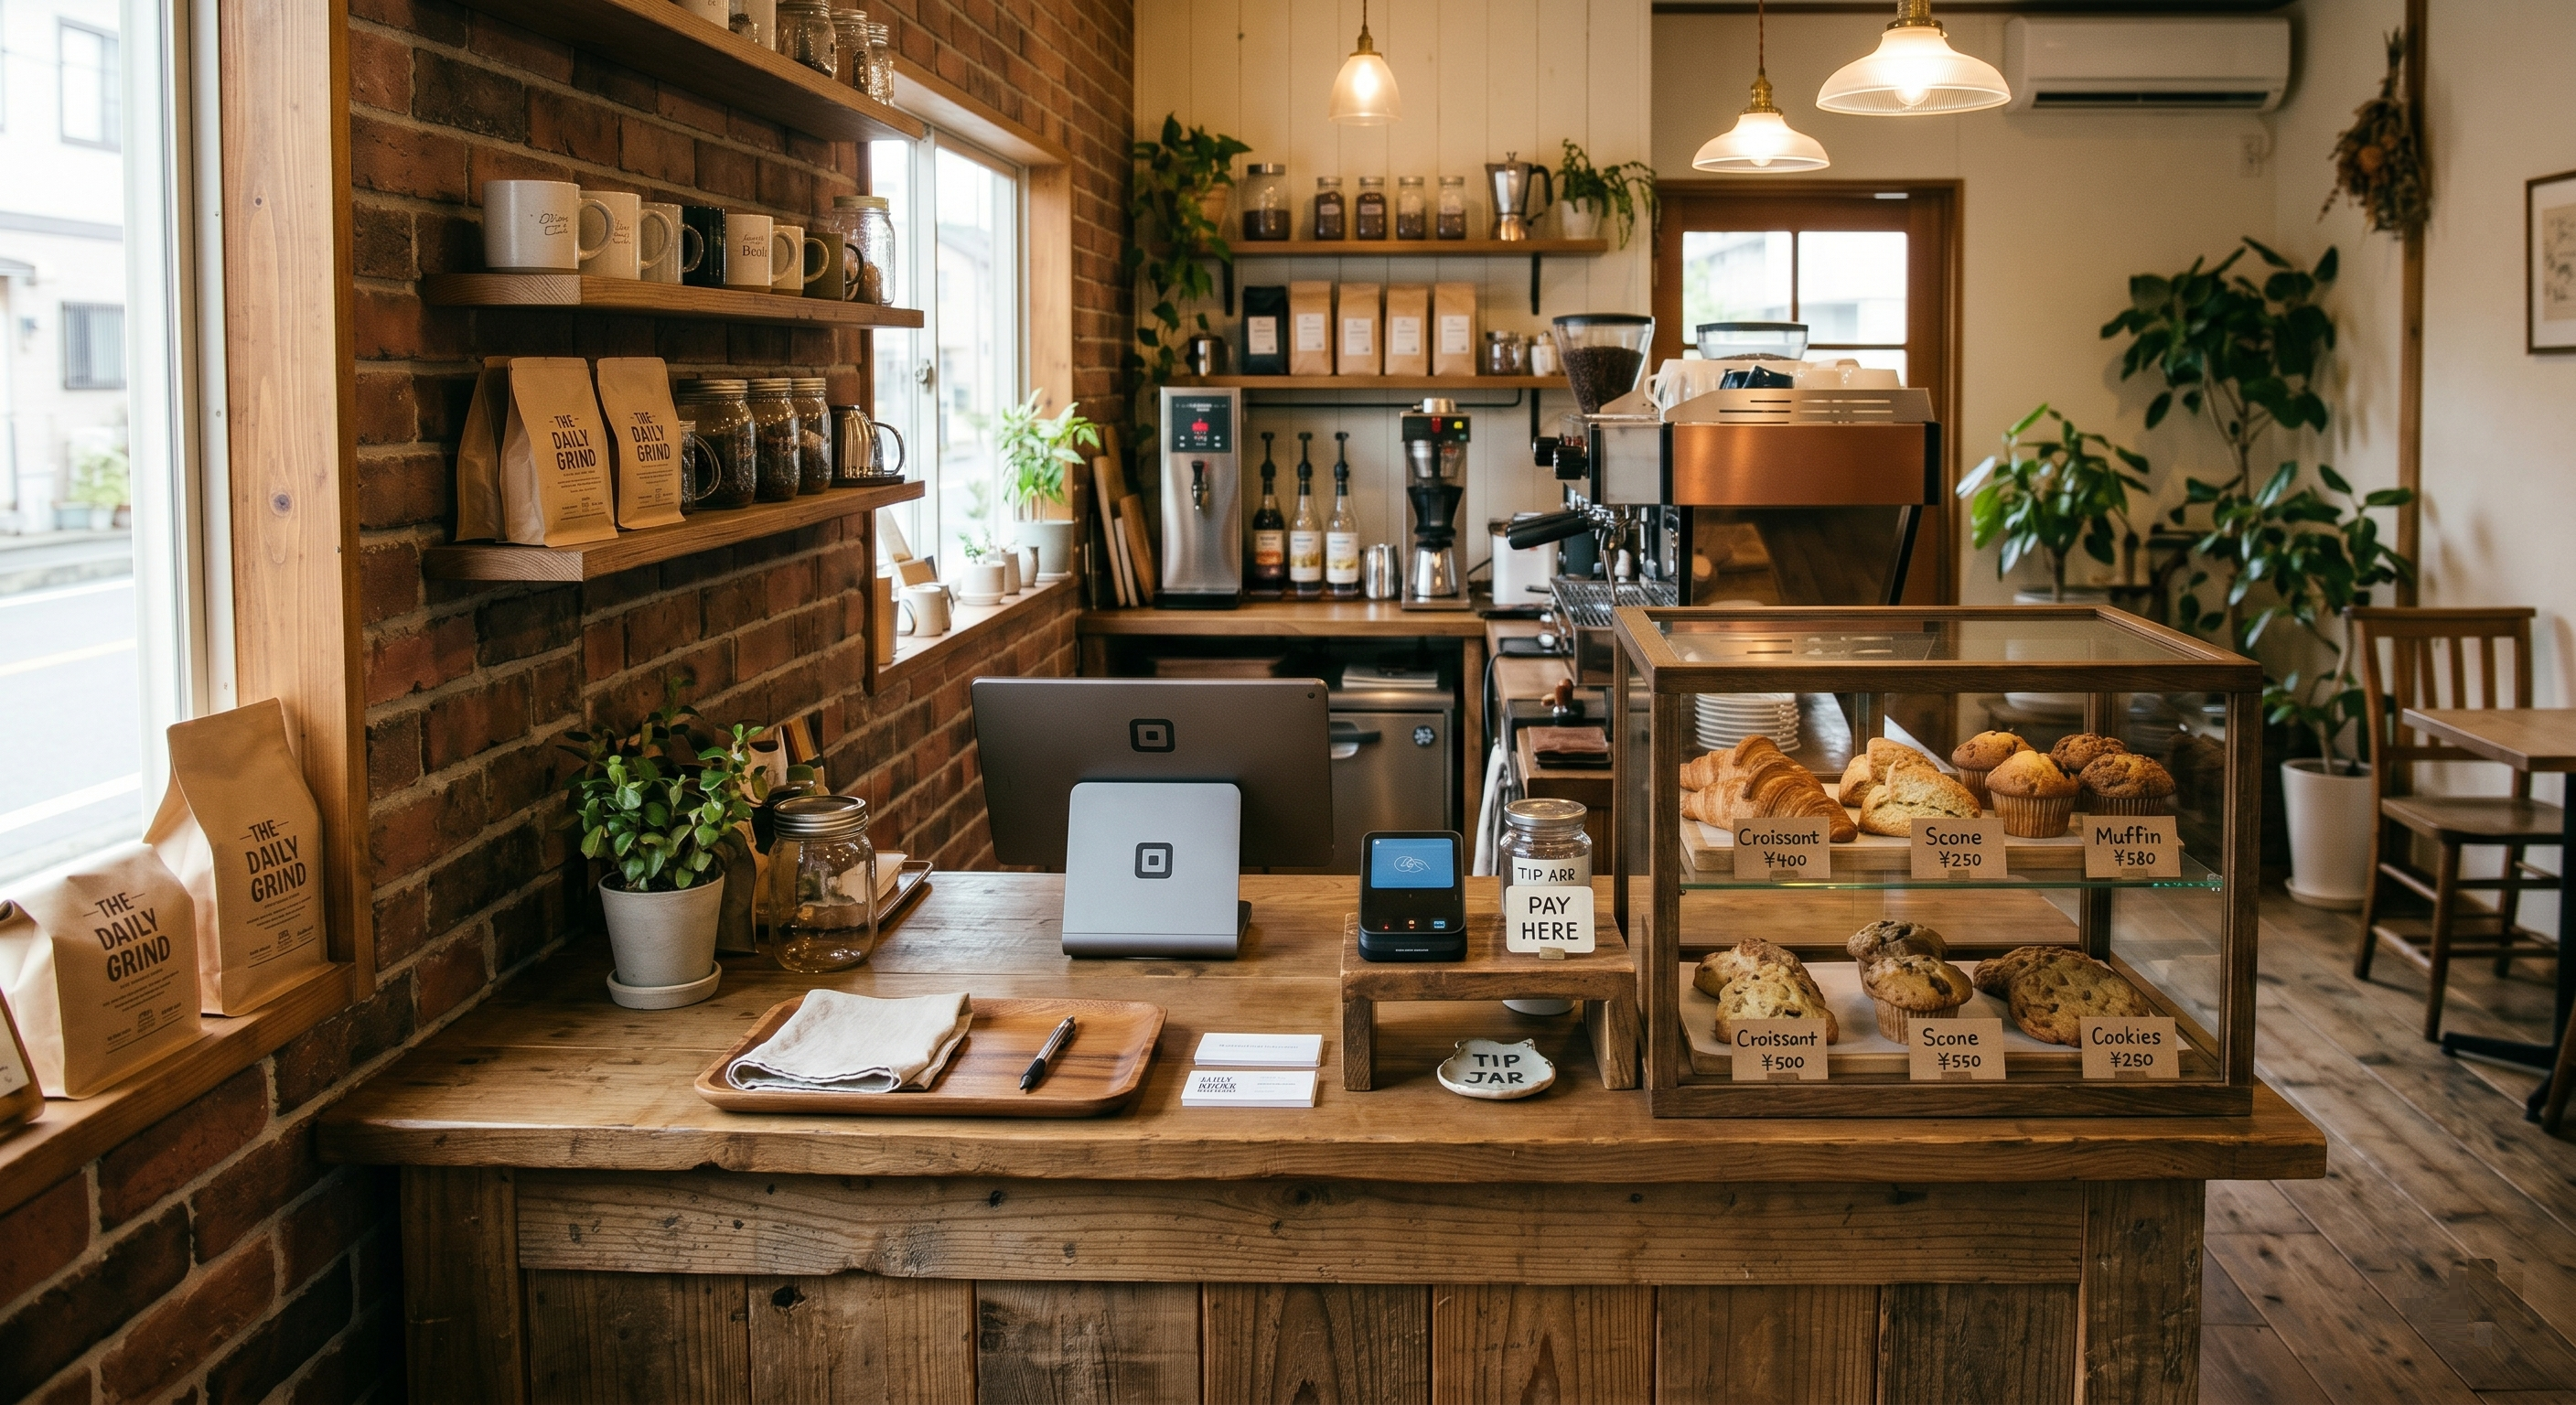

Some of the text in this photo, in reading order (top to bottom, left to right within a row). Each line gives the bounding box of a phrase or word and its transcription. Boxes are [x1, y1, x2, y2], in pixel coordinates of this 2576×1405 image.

[554, 414, 575, 429] THE
[551, 429, 589, 450] DAILY
[630, 424, 665, 443] DAILY
[556, 448, 596, 471] GRIND
[637, 443, 671, 463] GRIND
[248, 819, 280, 842] THE
[1738, 828, 1819, 846] Croissant
[1926, 826, 1982, 845] Scone
[2096, 825, 2162, 845] Muffin
[245, 834, 298, 875] DAILY
[1763, 851, 1808, 868] ¥400
[1938, 851, 1982, 868] ¥250
[2113, 849, 2156, 866] ¥580
[251, 862, 306, 903] GRIND
[1518, 866, 1575, 882] TIP ARR
[94, 891, 134, 918] THE
[1529, 896, 1572, 915] PAY
[93, 907, 158, 951] DAILY
[1521, 921, 1580, 940] HERE
[106, 935, 171, 982] GRIND
[1736, 1029, 1818, 1047] Croissant
[1922, 1027, 1980, 1046] Scone
[2091, 1025, 2162, 1045] Cookies
[1472, 1053, 1520, 1068] TIP
[1761, 1053, 1805, 1071] ¥500
[1937, 1052, 1981, 1070] ¥550
[1464, 1071, 1525, 1084] JAR
